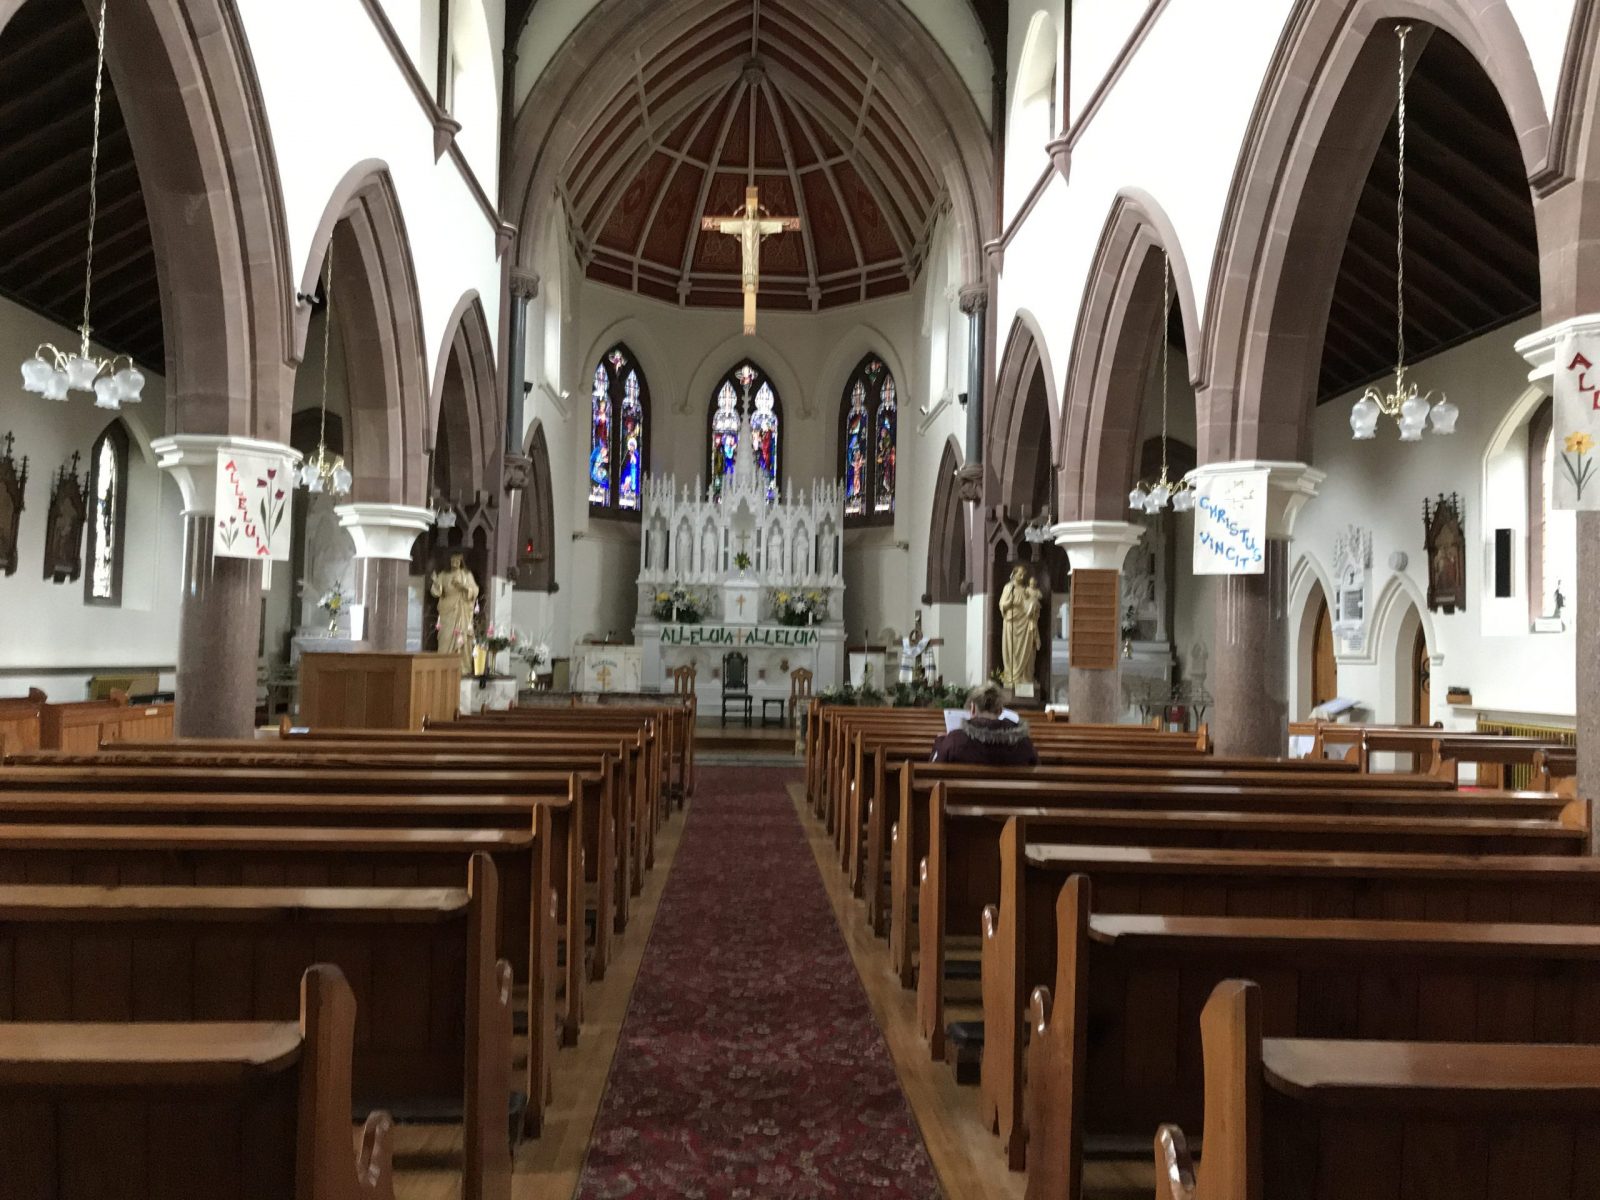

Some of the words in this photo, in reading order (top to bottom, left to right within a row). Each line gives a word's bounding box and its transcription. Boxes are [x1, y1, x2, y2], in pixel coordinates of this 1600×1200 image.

[225, 460, 270, 555] ALLELUIA
[1200, 496, 1262, 562] CHRISTUS
[1199, 531, 1249, 568] VINCIT
[661, 626, 734, 645] ALLELUIA
[744, 627, 818, 647] ALLELUIA
